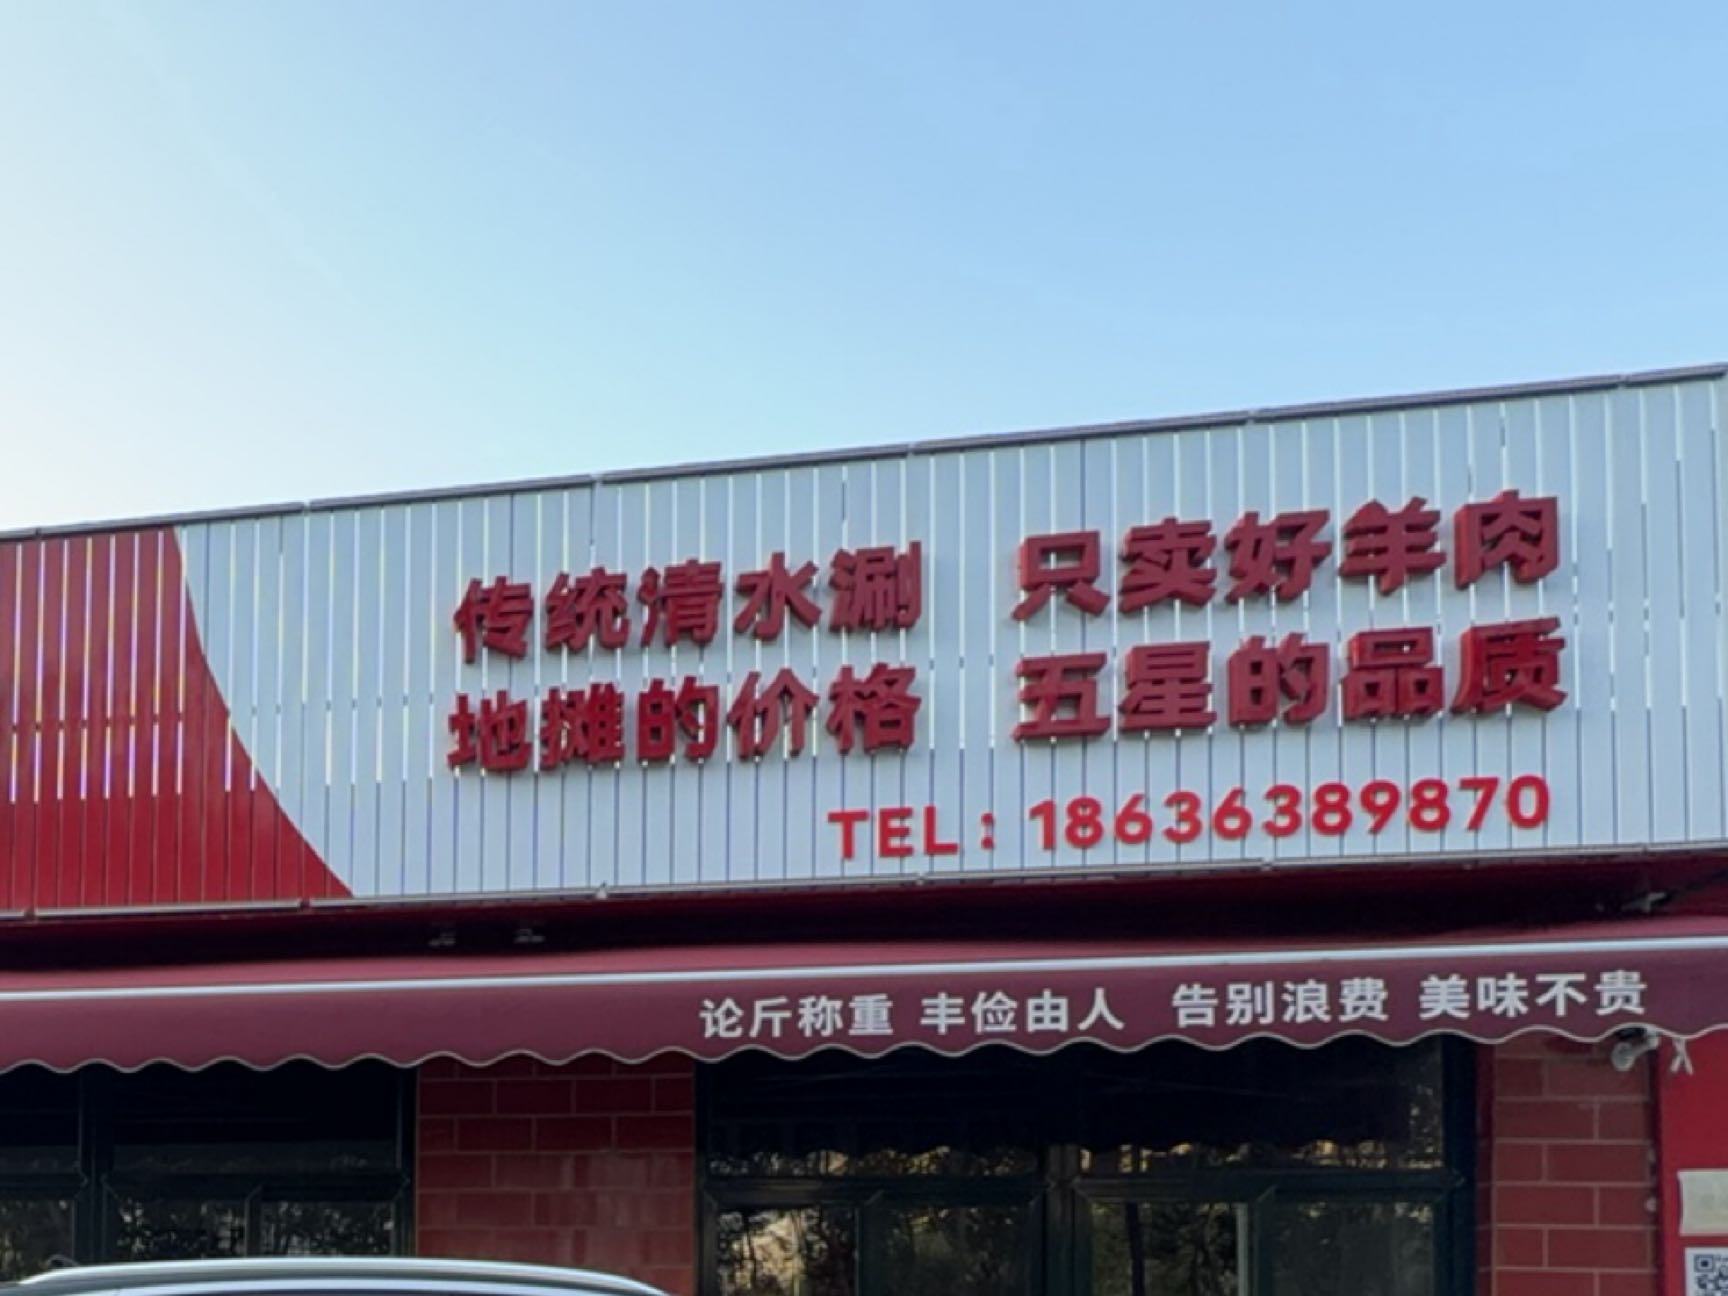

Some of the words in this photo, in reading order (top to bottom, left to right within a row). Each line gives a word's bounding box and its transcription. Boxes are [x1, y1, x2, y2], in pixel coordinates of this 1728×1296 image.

[452, 541, 923, 664] 传统清水涮
[1010, 488, 1561, 622] 只卖好羊肉
[446, 662, 922, 773] 地摊的价格
[1011, 616, 1569, 744] 五星的品质
[1028, 774, 1552, 852] 18636389870
[699, 993, 894, 1039] 论斤称重
[920, 987, 1125, 1036] 丰俭由人
[1171, 976, 1390, 1029] 告别浪费
[1418, 969, 1648, 1020] 美味不贵
